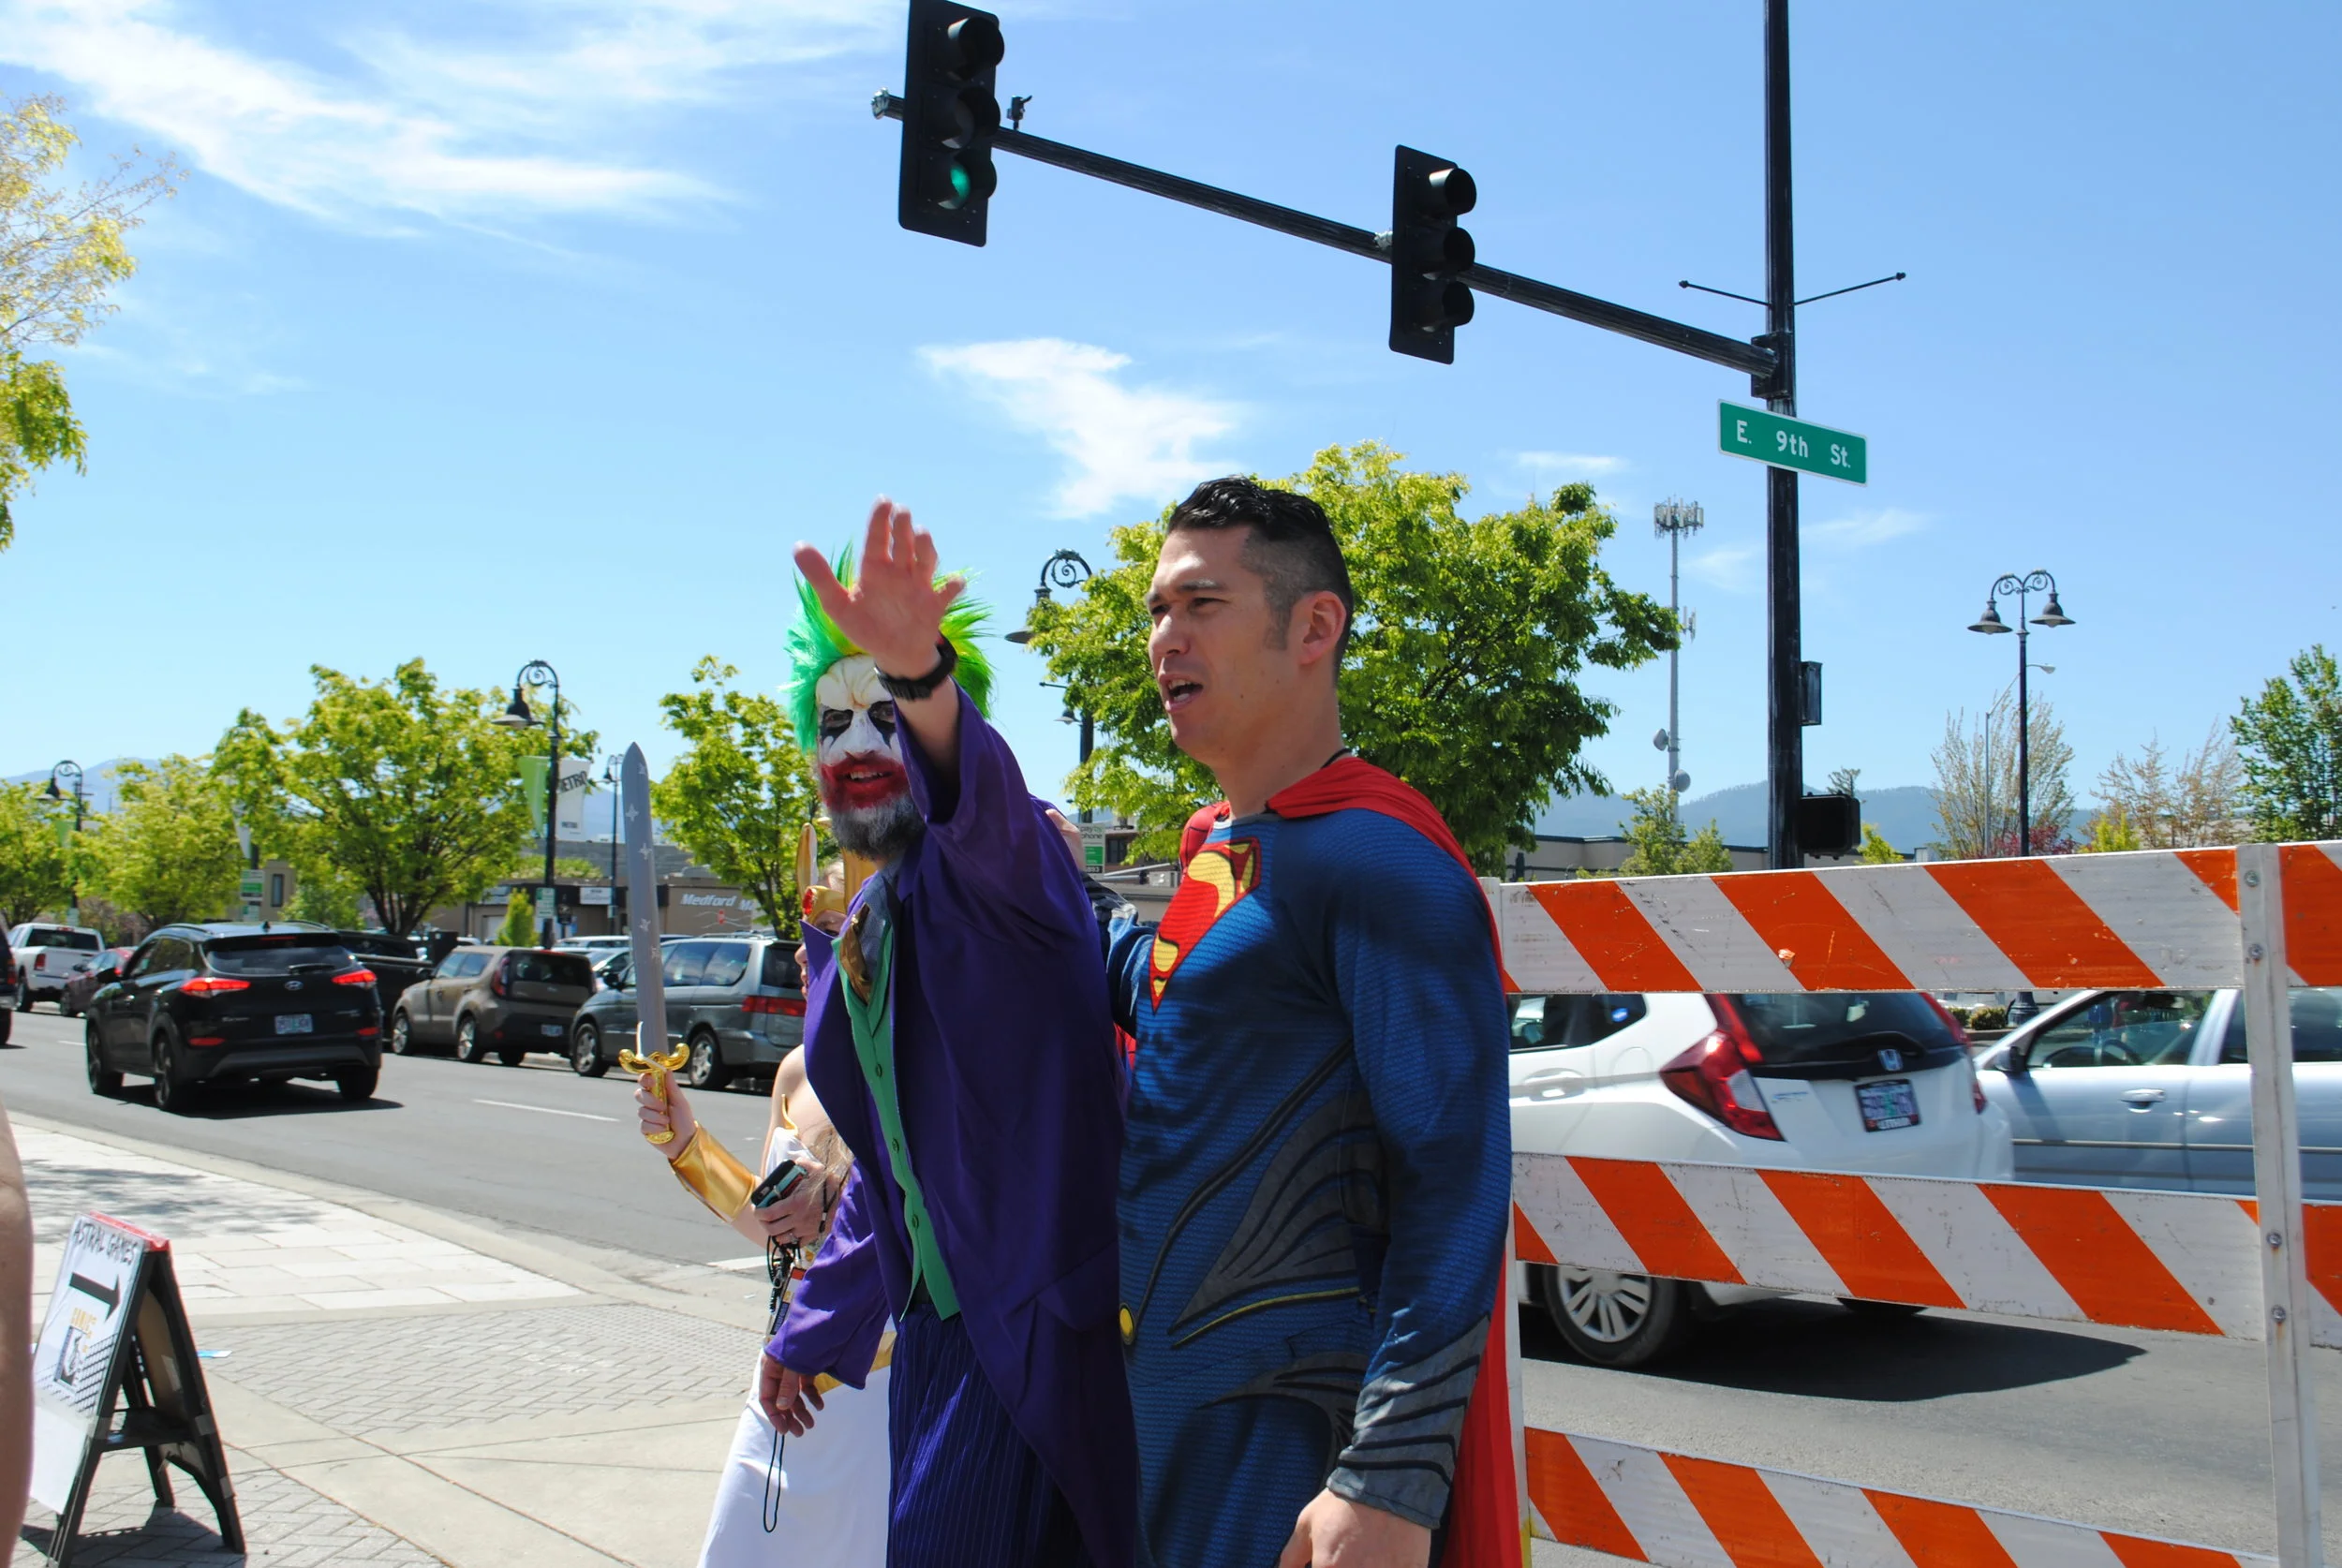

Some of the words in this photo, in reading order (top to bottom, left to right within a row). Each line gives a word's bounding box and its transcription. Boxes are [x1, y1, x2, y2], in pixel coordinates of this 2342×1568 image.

[1737, 420, 1752, 445] E.
[1776, 430, 1809, 458] 9th
[1831, 443, 1851, 468] St.
[680, 893, 737, 907] Medford
